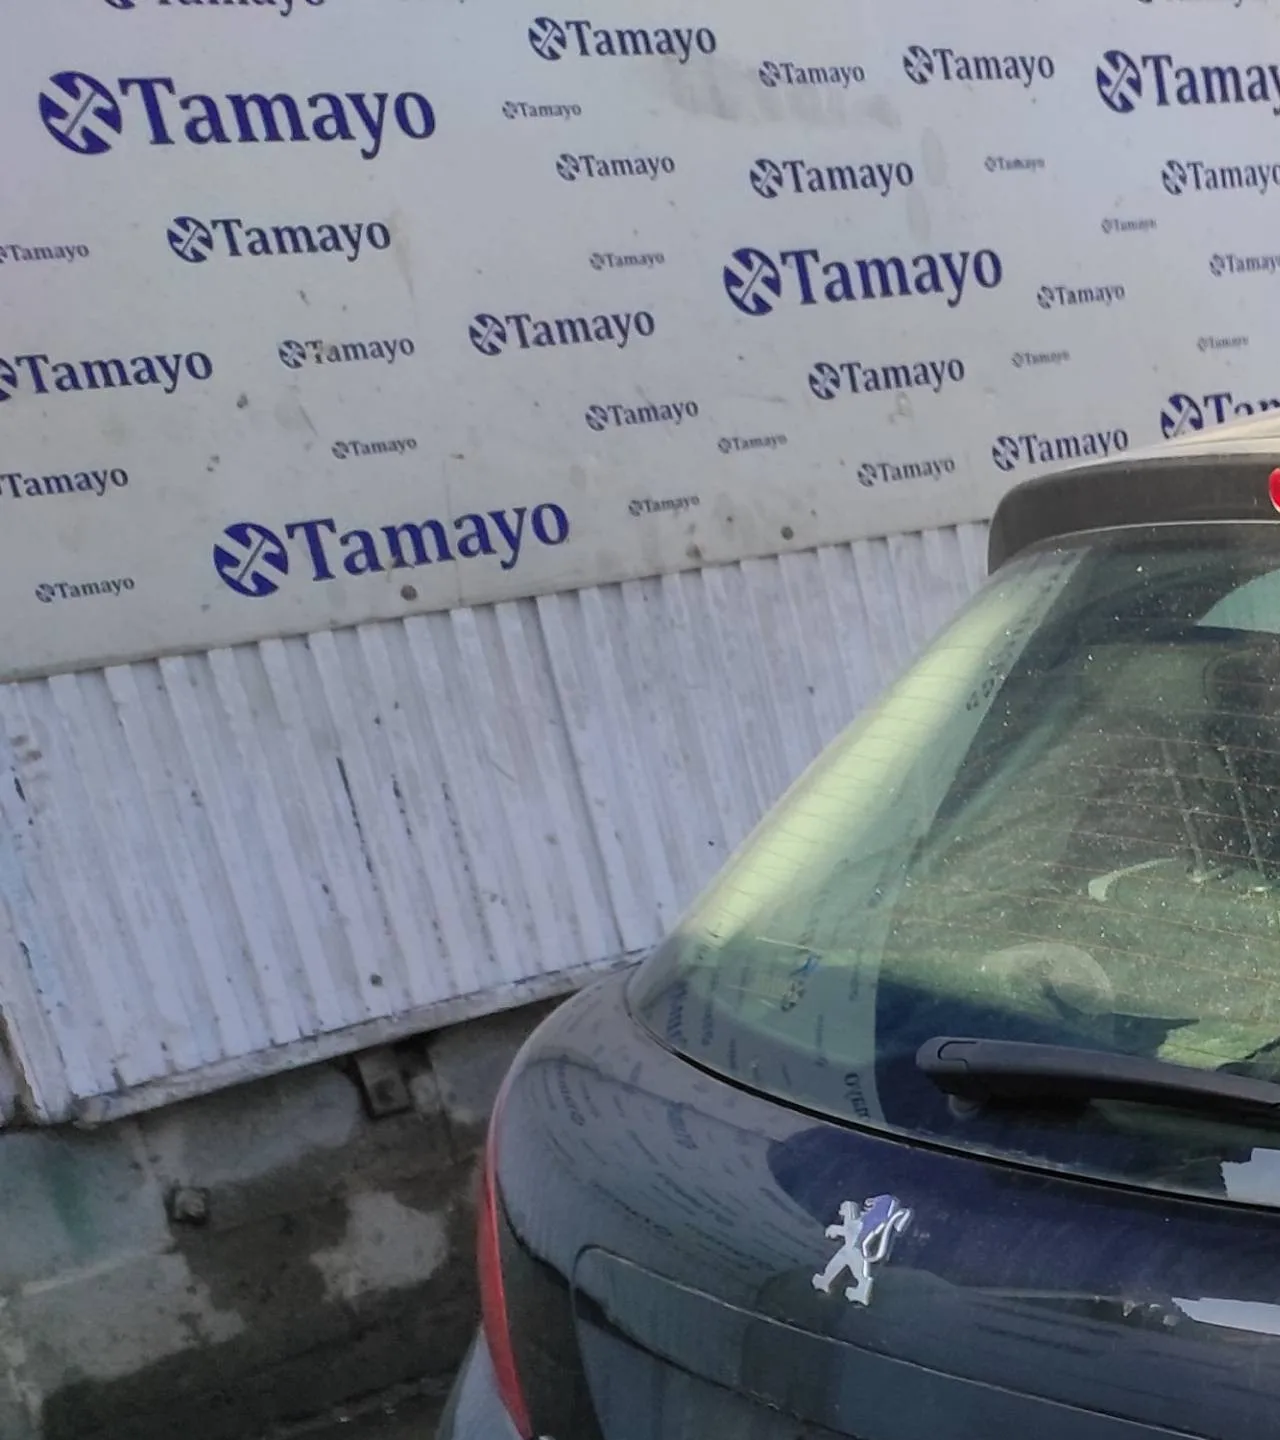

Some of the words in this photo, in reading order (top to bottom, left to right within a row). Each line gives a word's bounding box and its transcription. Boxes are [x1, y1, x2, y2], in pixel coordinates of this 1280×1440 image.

[567, 19, 717, 58] Tamayo
[780, 62, 866, 88] Tamayo
[932, 48, 1055, 86] Tamayo
[119, 76, 436, 161] Tamayo
[515, 101, 582, 120] Tamayo
[580, 154, 676, 181] Tamayo
[781, 159, 914, 197] Tamayo
[7, 244, 90, 263] Tamayo
[211, 218, 391, 263] Tamayo
[605, 252, 665, 269] Tamayo
[780, 248, 1003, 309] Tamayo
[1053, 285, 1125, 306] Tamayo
[506, 311, 655, 349] Tamayo
[309, 338, 415, 365] Tamayo
[14, 351, 213, 395] Tamayo
[839, 359, 965, 394] Tamayo
[608, 400, 699, 427] Tamayo
[351, 437, 418, 457] Tamayo
[1018, 429, 1128, 466] Tamayo
[0, 468, 129, 499] Tamayo
[877, 458, 956, 483] Tamayo
[287, 502, 570, 582] Tamayo
[51, 577, 135, 599] Tamayo
